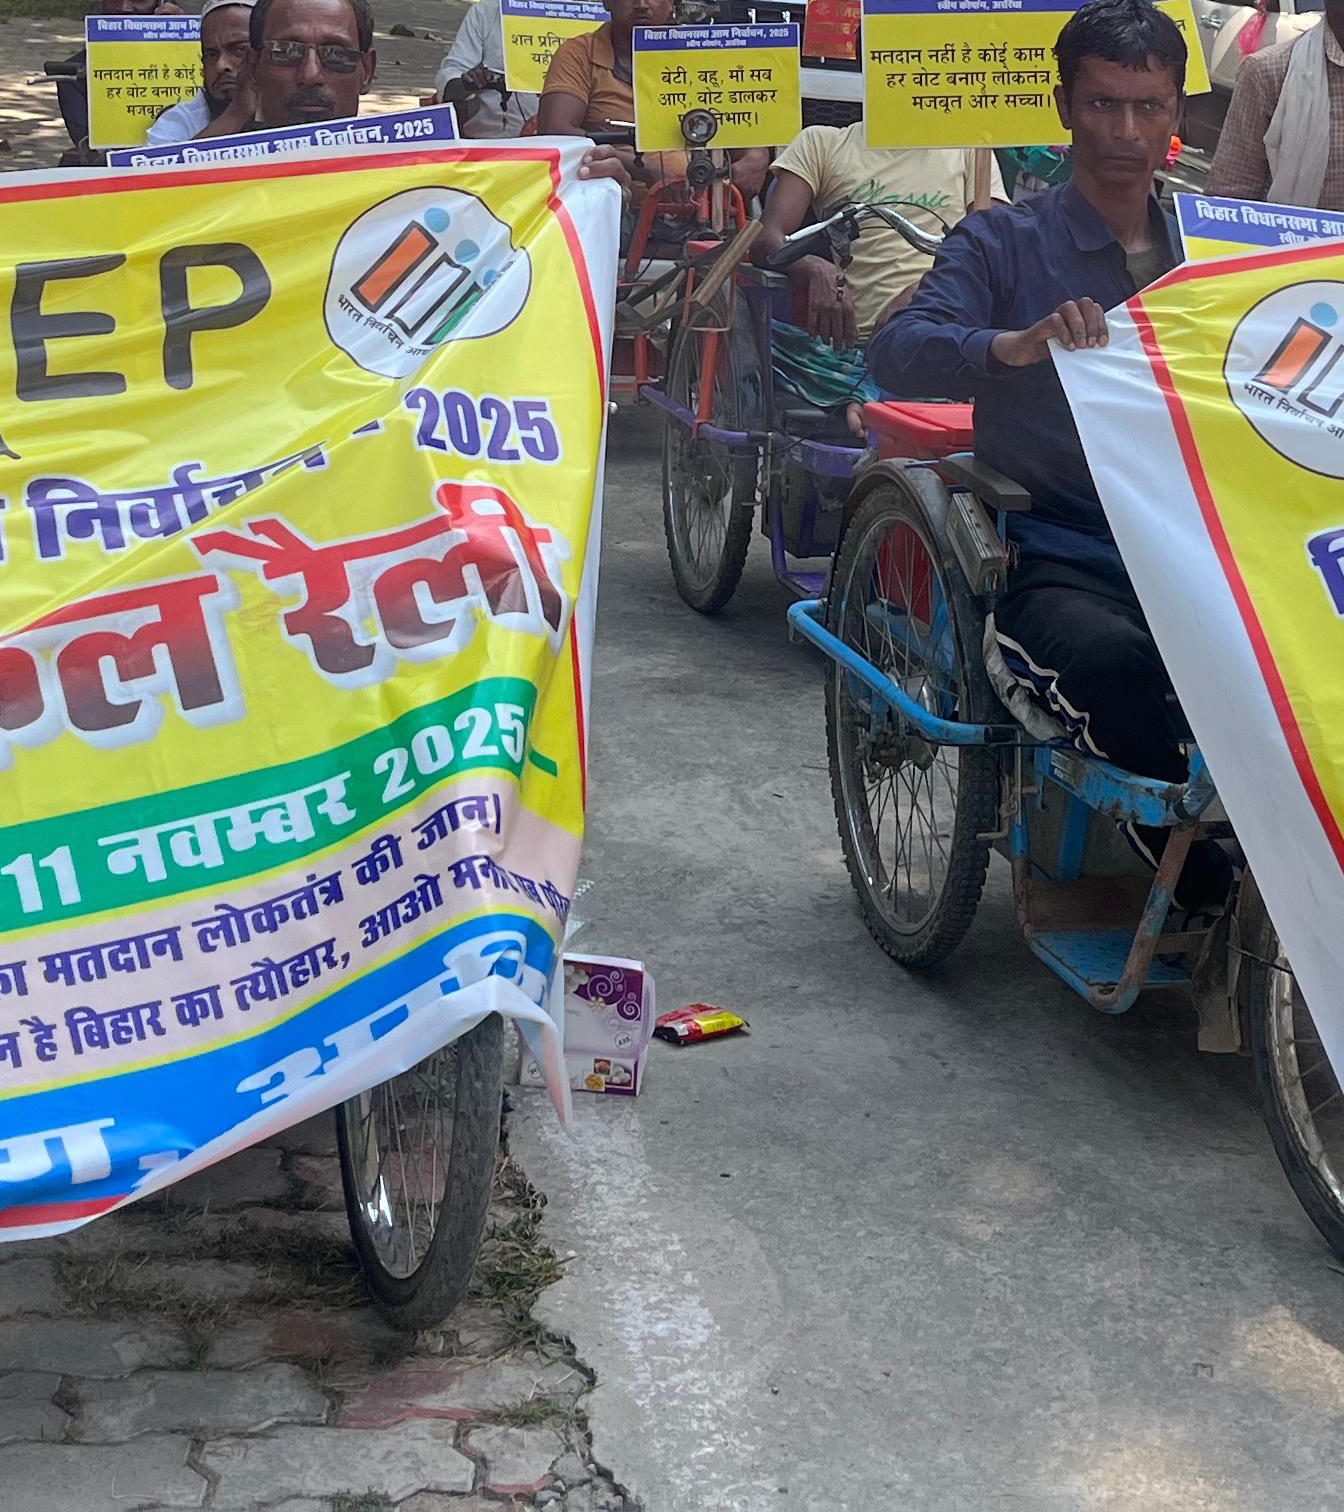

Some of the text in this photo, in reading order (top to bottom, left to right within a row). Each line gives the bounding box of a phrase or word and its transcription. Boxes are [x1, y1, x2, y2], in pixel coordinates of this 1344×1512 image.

[870, 42, 1046, 68] मतदान नहीं है कोई काम
[885, 64, 1051, 94] हर वोट बनाए लोकतंत्र
[969, 89, 1000, 110] और
[1004, 92, 1052, 110] सच्चा।
[406, 387, 561, 465] 2025
[191, 482, 562, 676] रैली
[1, 844, 81, 915] 11
[97, 770, 358, 884] नवम्बर
[373, 701, 527, 803] 2025
[32, 1018, 57, 1064] है
[64, 998, 166, 1058] बिहार
[174, 980, 225, 1026] का
[230, 934, 352, 1014] त्यौहार,
[357, 872, 444, 950] आओ
[37, 920, 184, 986] मतदान
[191, 872, 346, 952] लोकतंत्र
[352, 836, 404, 889] की
